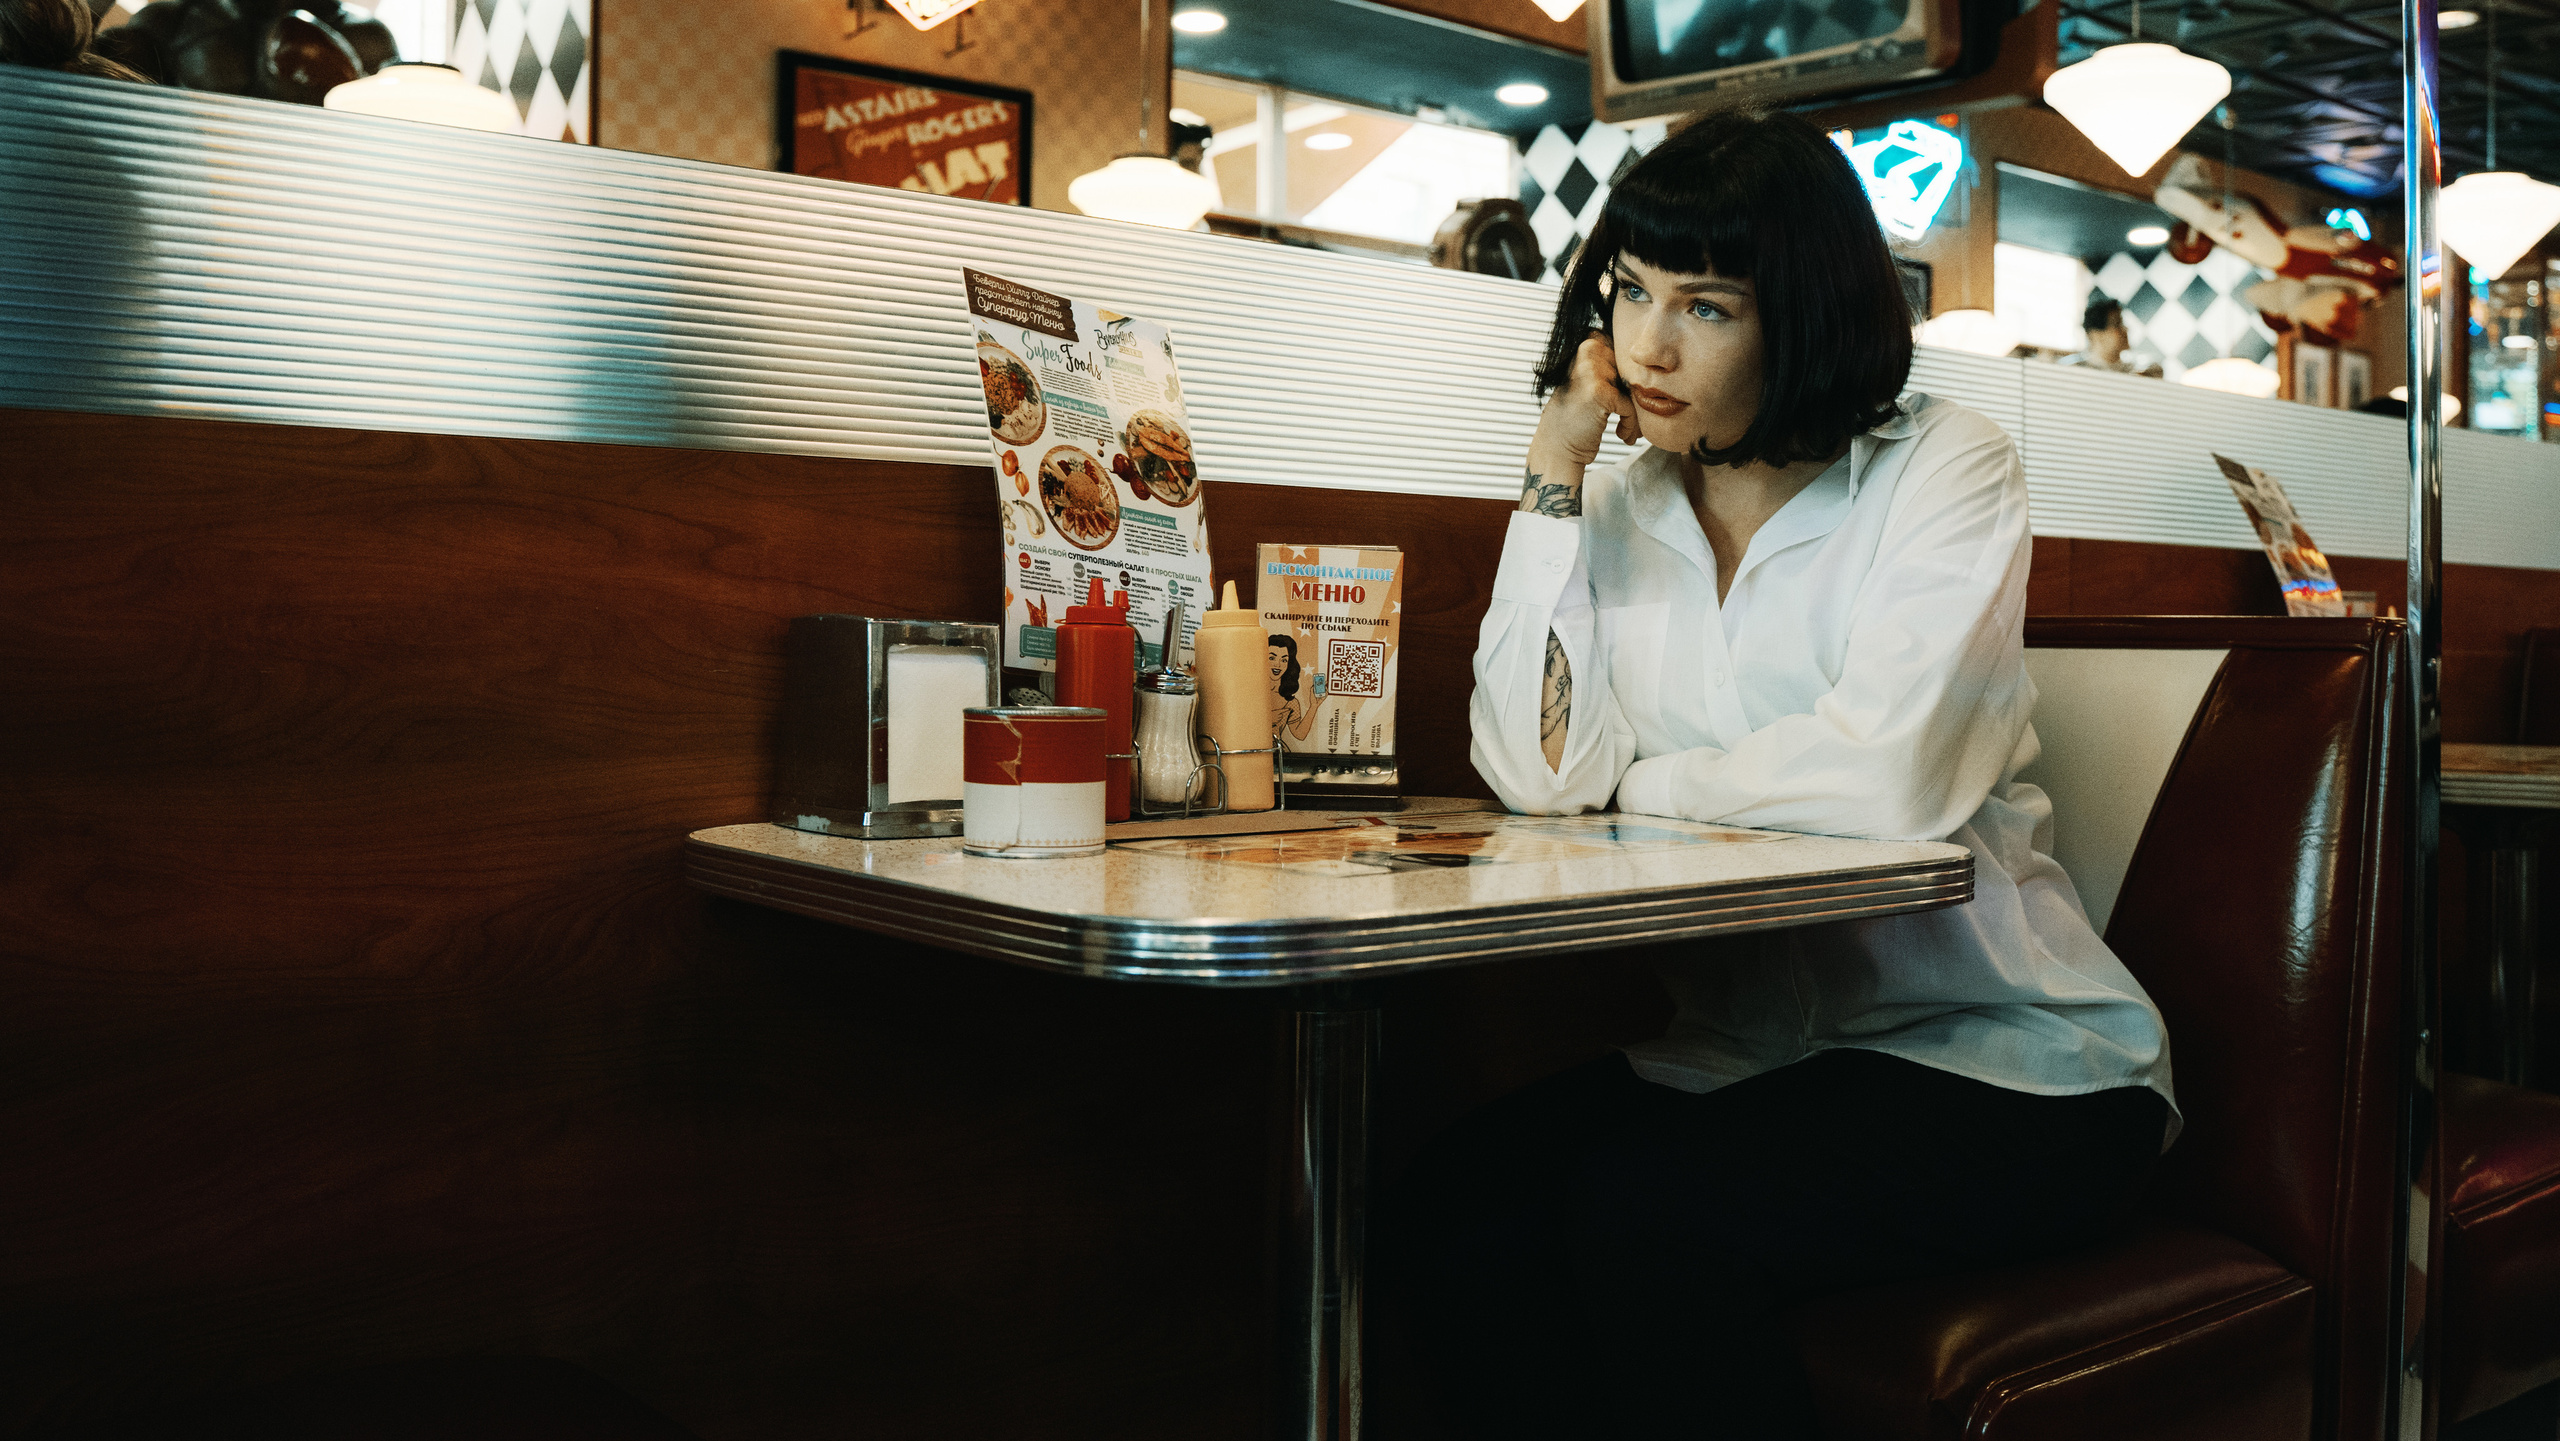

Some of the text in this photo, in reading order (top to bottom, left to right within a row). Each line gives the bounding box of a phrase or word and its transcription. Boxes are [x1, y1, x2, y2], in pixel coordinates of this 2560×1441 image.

[973, 274, 1005, 291] Беверли
[1032, 292, 1060, 308] Дайнер
[975, 286, 1063, 319] представляет новинку
[977, 297, 1065, 331] Суперфуд Меню
[1021, 330, 1063, 367] Super
[1060, 343, 1102, 380] Foods
[1019, 543, 1047, 554] СОЗДАЙ
[1048, 547, 1067, 558] СВОЙ
[1068, 552, 1124, 569] СУПЕРПОЛЕЗНЫЙ
[1124, 562, 1145, 572] САЛАТ
[1155, 568, 1185, 580] ПРОСТЫХ
[1185, 575, 1202, 583] ШАГА
[1267, 562, 1394, 582] БЕСКОНТАКТНОЕ
[1291, 581, 1366, 604] МЕНЮ
[1264, 611, 1390, 627] СКАНИРУЙТЕ И ПЕРЕХОДИТЕ
[1301, 622, 1352, 633] ПО ССЫЛКЕ
